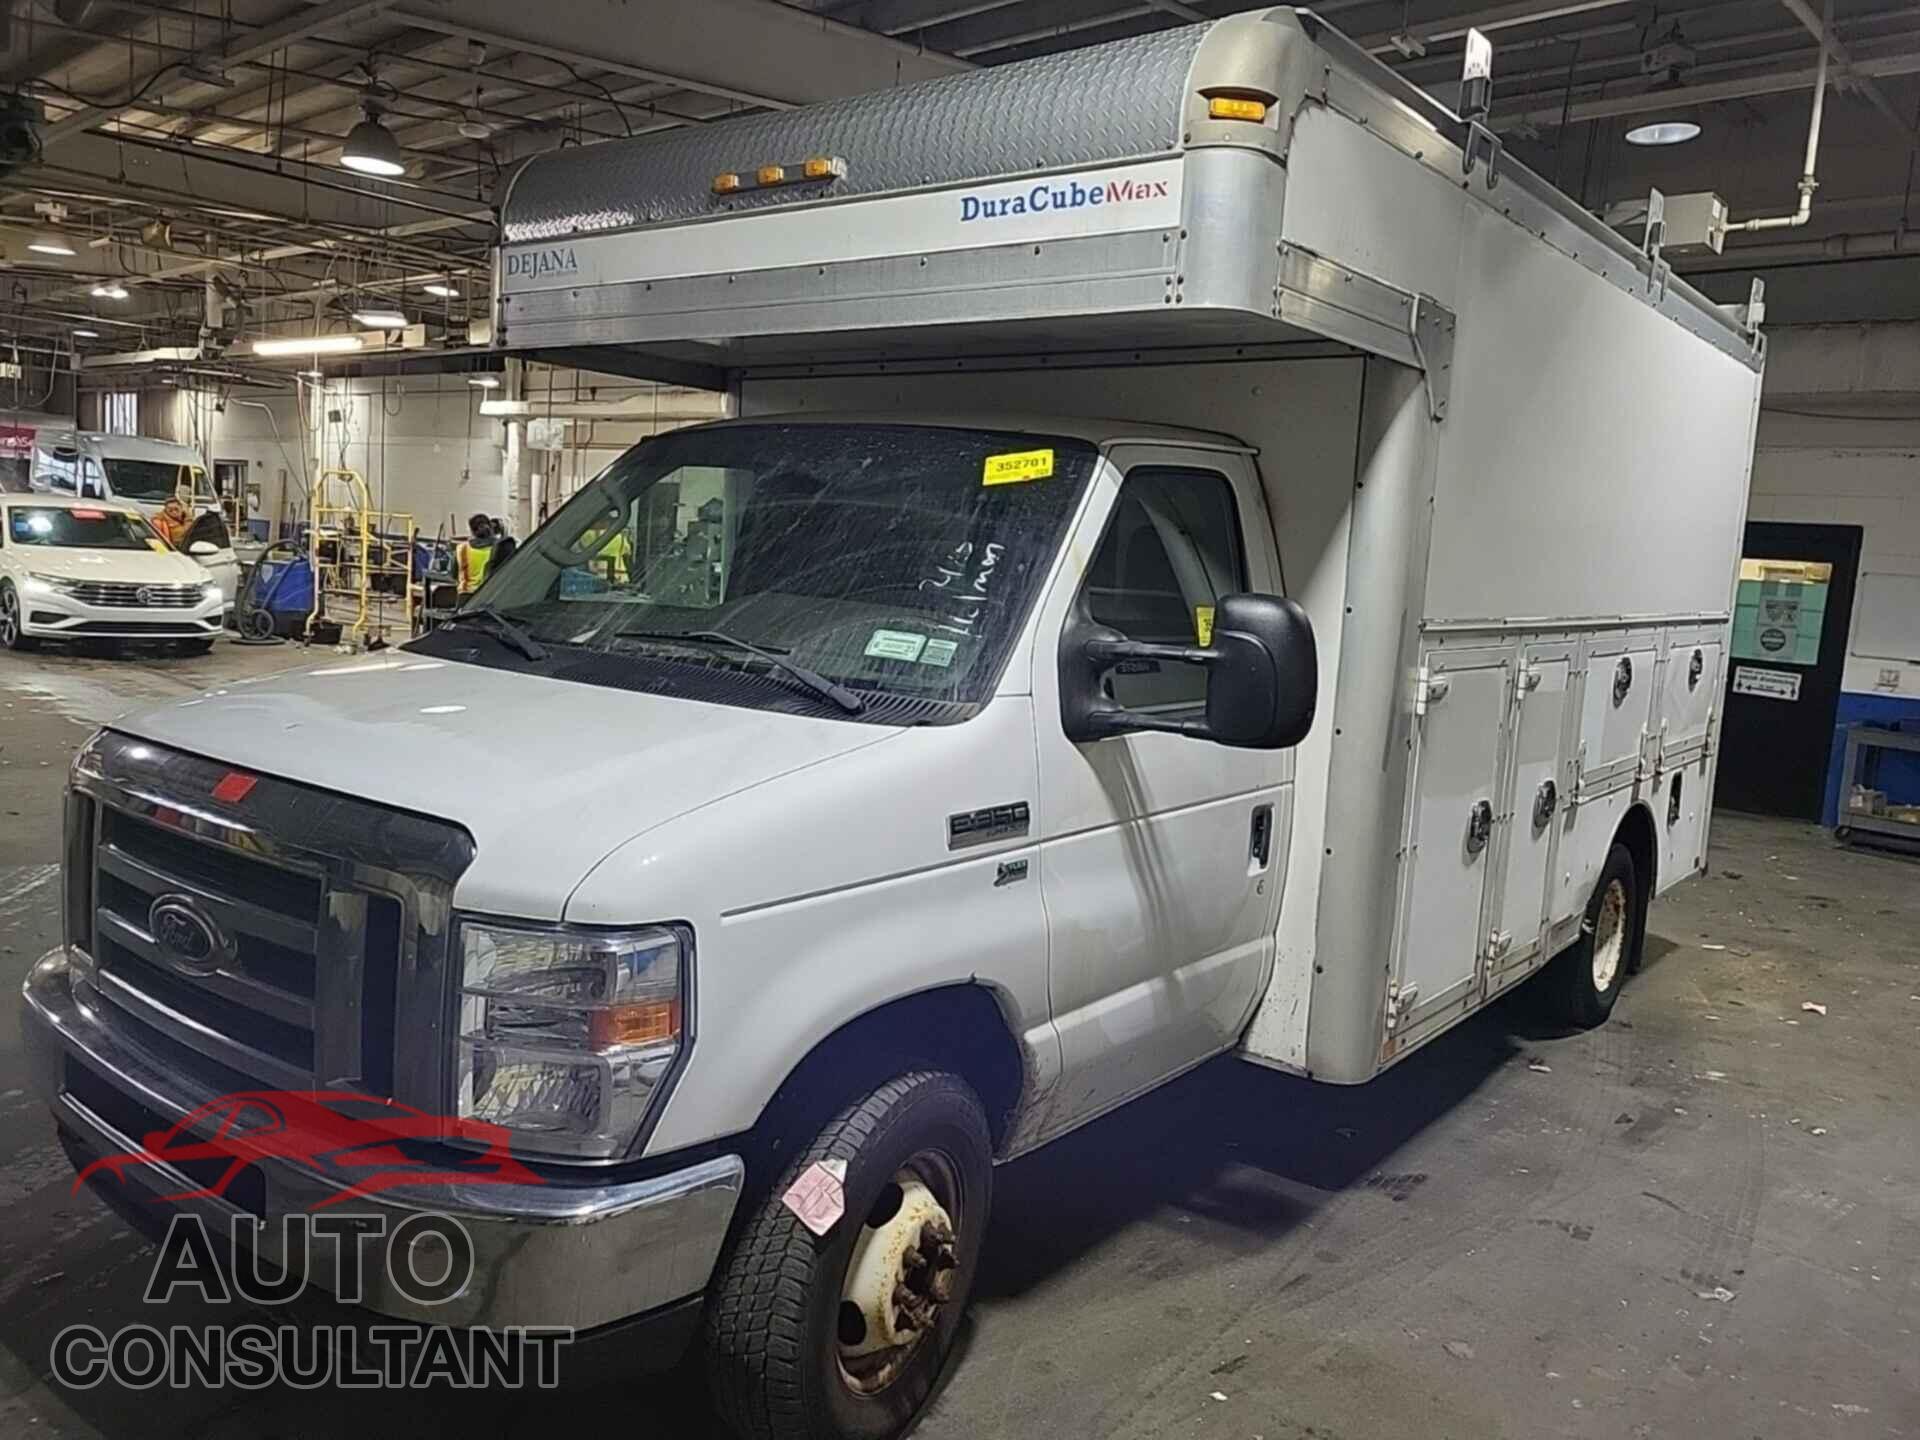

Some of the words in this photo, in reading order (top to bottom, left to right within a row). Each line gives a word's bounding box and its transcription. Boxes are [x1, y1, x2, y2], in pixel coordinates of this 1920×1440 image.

[961, 179, 1168, 222] DuraCubeMax
[507, 247, 577, 279] DEJANA
[995, 457, 1047, 473] 352701
